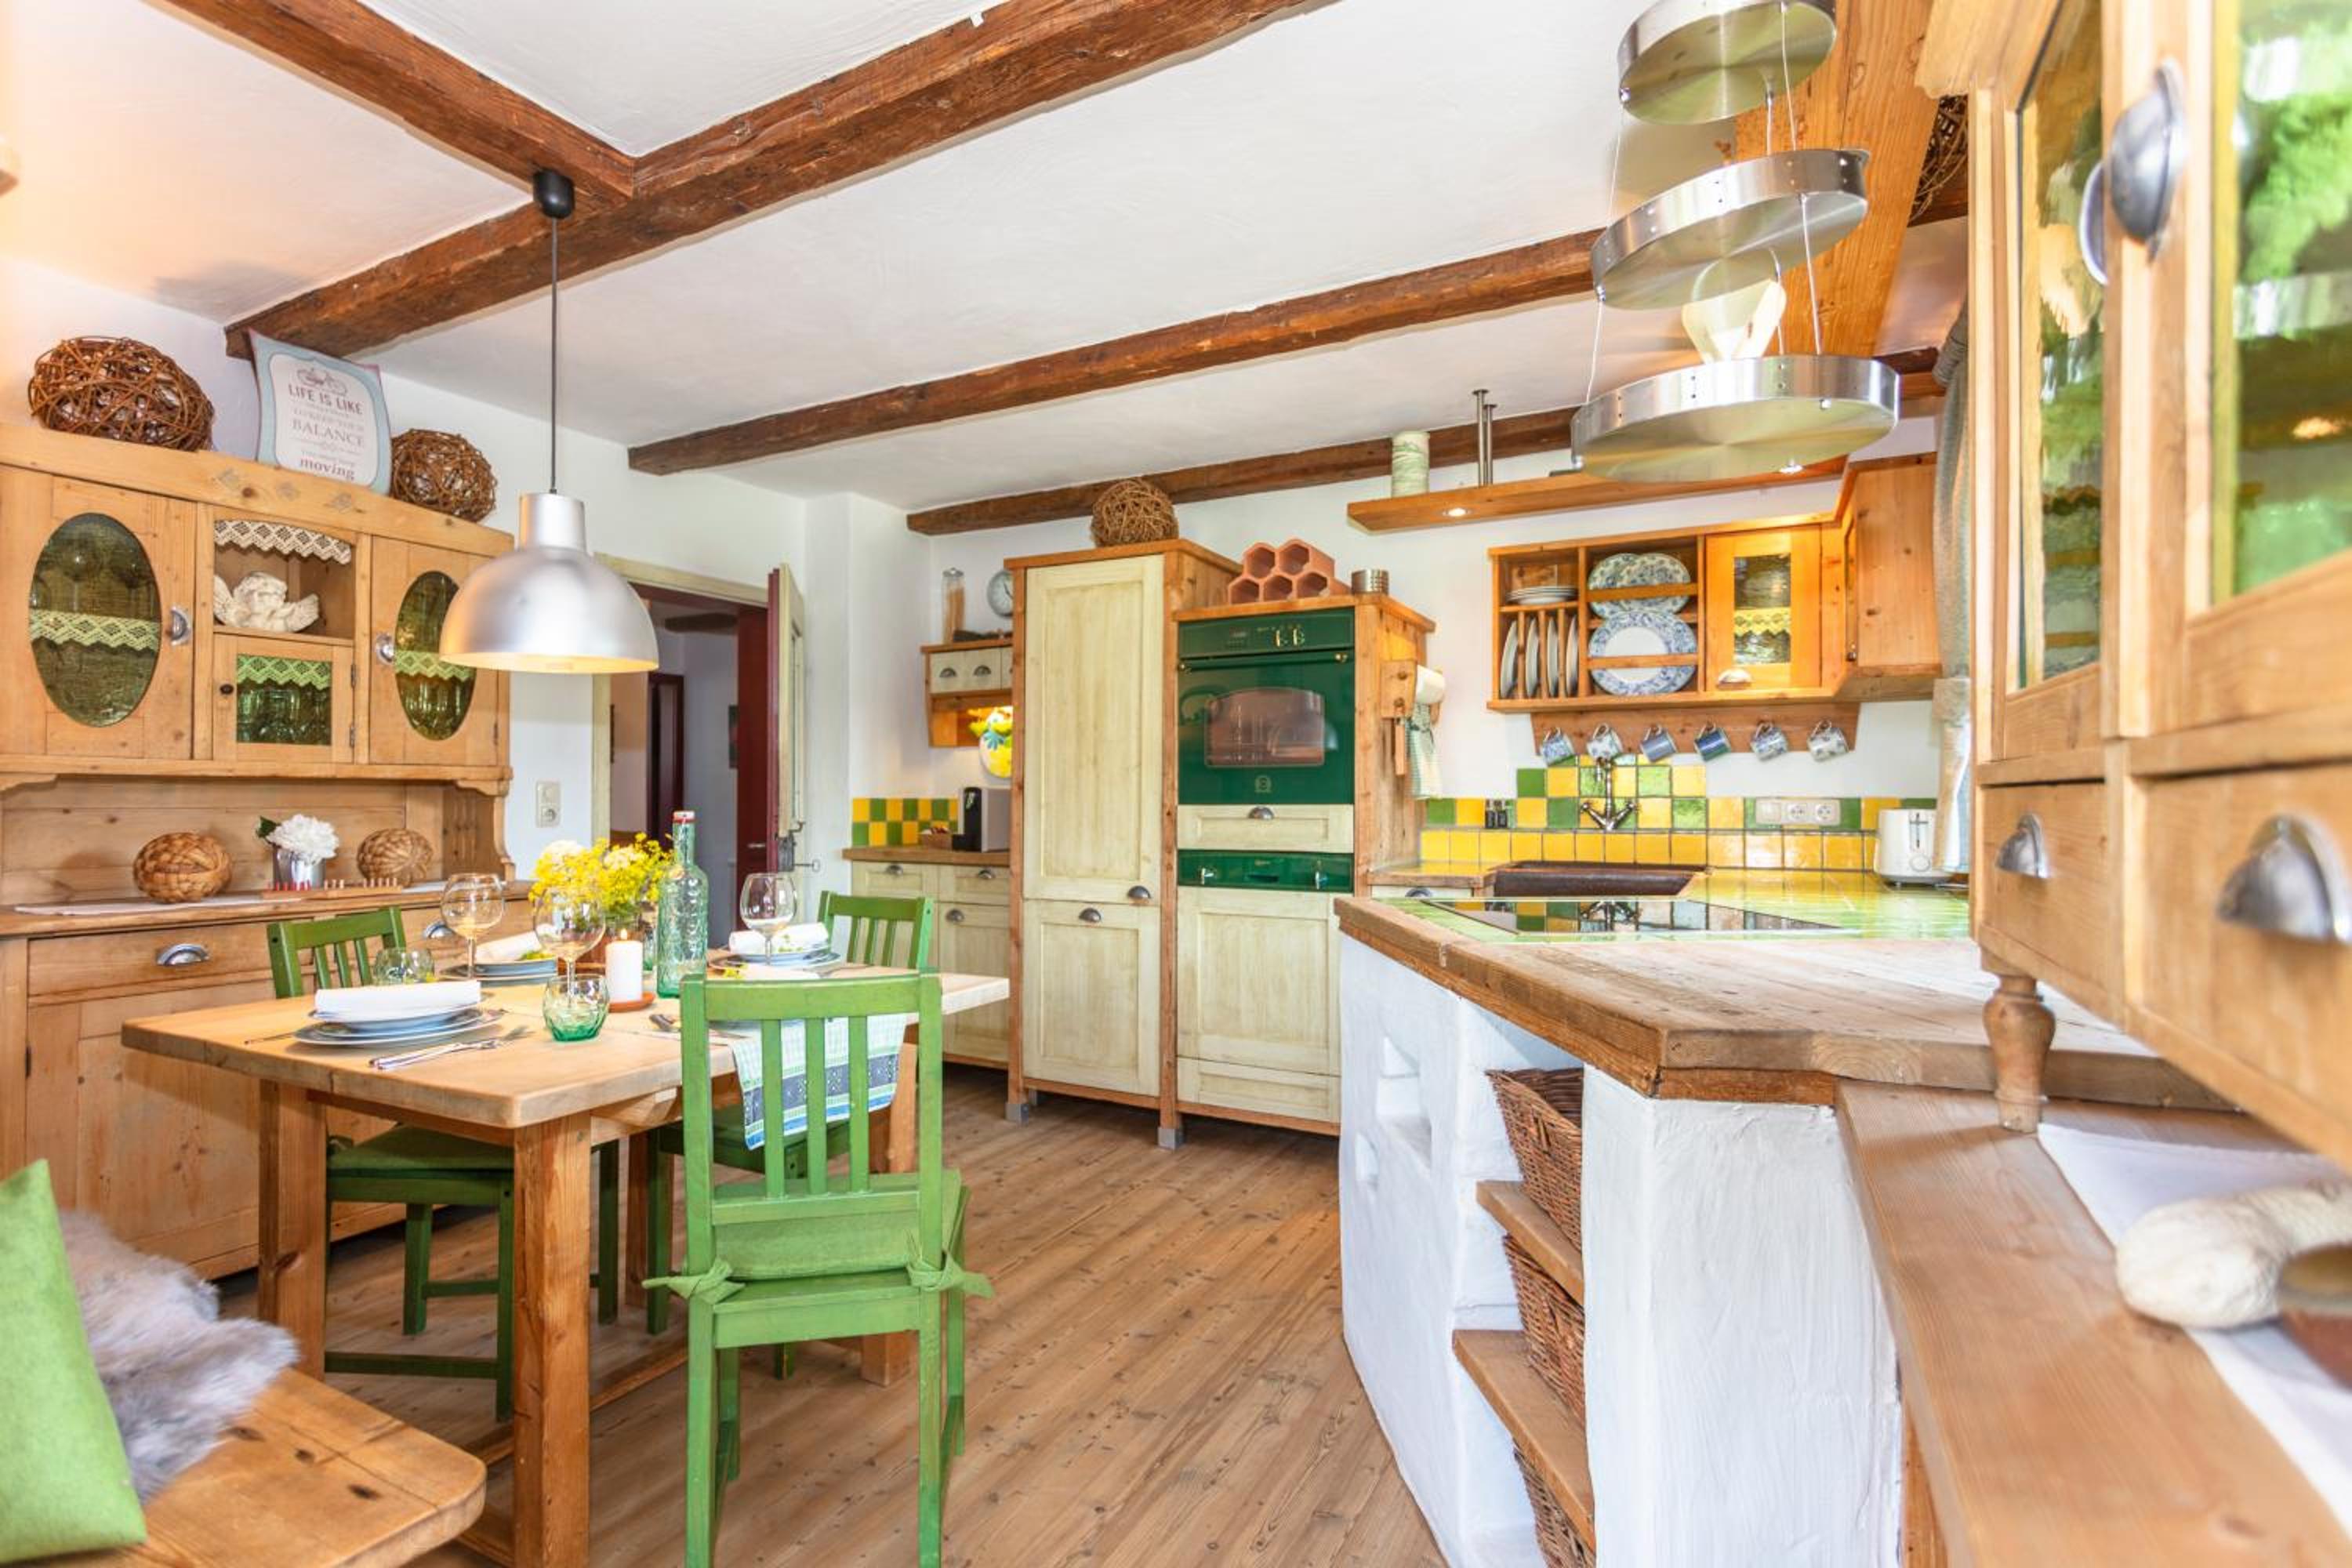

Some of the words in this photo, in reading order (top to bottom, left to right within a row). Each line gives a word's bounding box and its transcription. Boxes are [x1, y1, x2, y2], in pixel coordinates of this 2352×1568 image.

[289, 383, 314, 401] LIFE
[320, 392, 332, 407] IS
[336, 397, 362, 415] LIKE
[292, 419, 363, 447] BALANCE
[301, 458, 355, 481] moving
